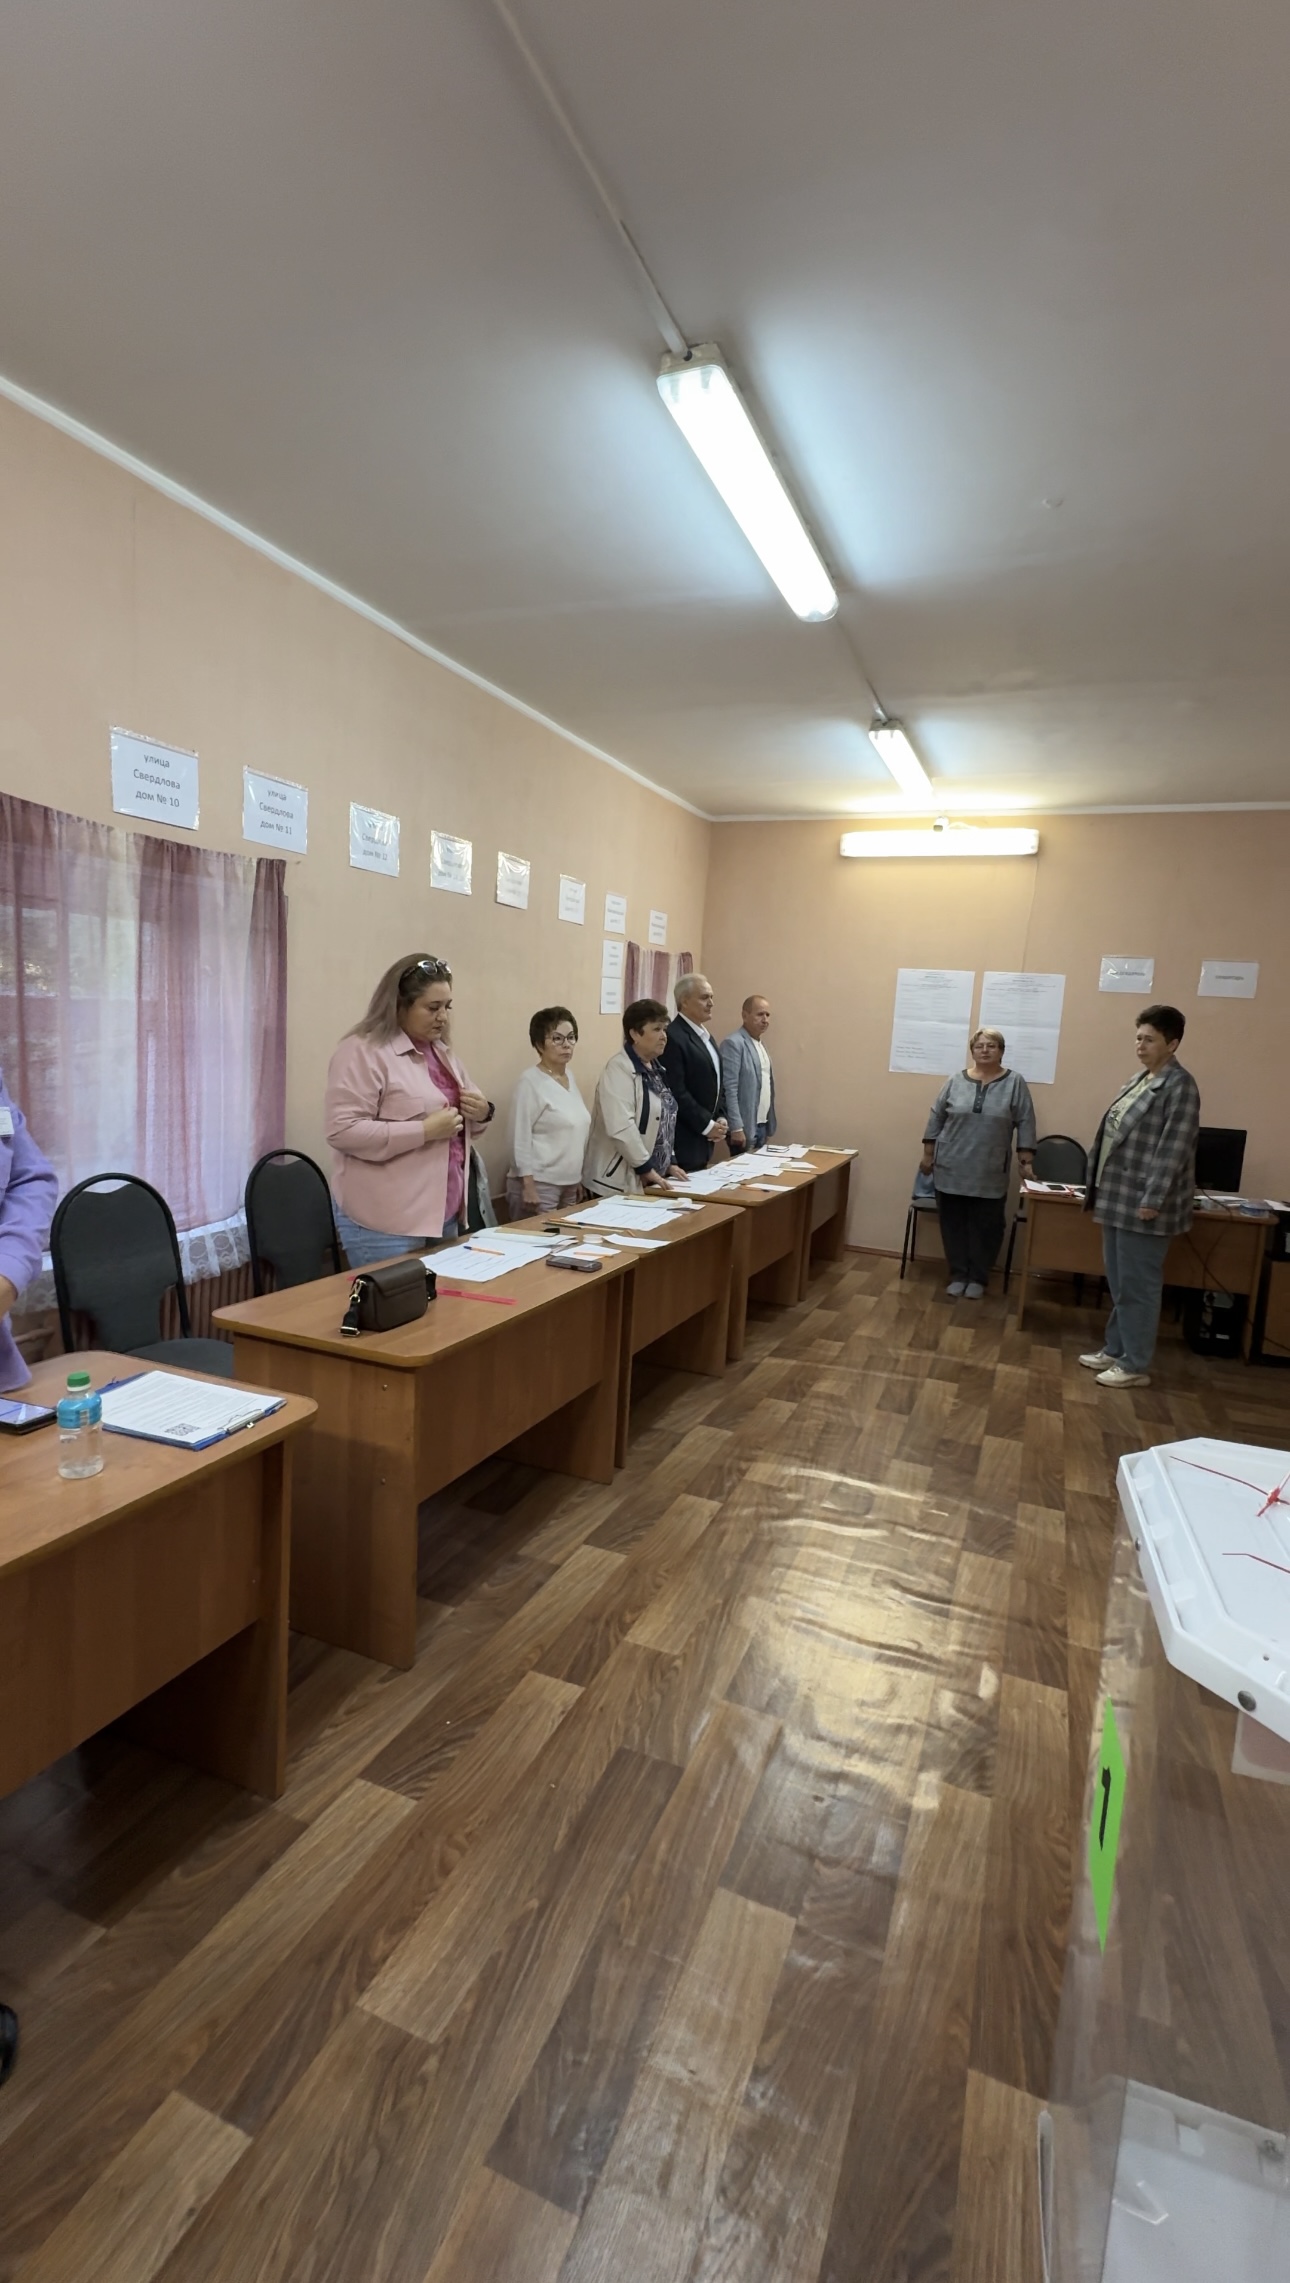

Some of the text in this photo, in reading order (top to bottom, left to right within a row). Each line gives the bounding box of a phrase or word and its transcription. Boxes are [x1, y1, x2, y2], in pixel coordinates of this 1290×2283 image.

[143, 754, 170, 769] улица
[133, 768, 181, 790] Свердлова
[135, 790, 180, 808] дом № 10
[267, 789, 287, 801] улица
[259, 801, 294, 820] Свердлова
[260, 820, 275, 831] дом
